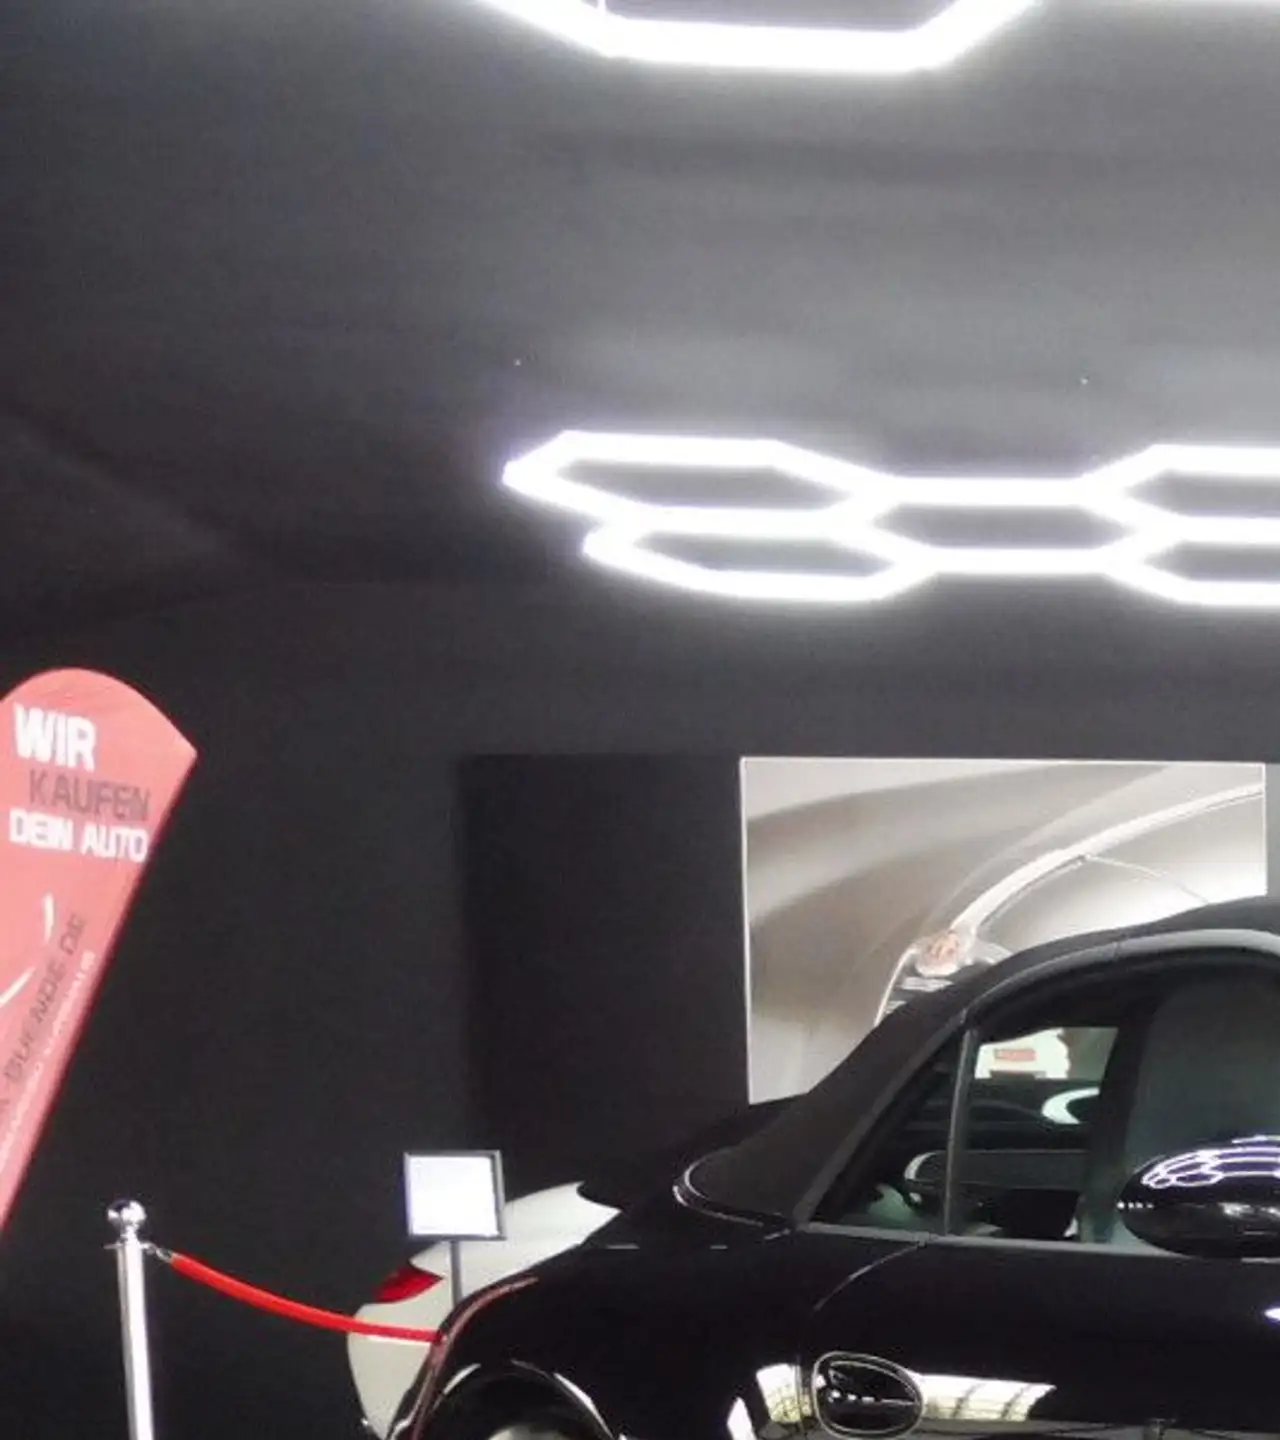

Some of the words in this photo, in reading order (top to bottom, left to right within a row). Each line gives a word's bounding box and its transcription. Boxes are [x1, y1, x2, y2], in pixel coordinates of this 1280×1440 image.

[13, 702, 95, 772] WIR
[30, 769, 149, 821] KAUFEN
[10, 807, 73, 851] DEIN
[81, 821, 149, 864] AUTO
